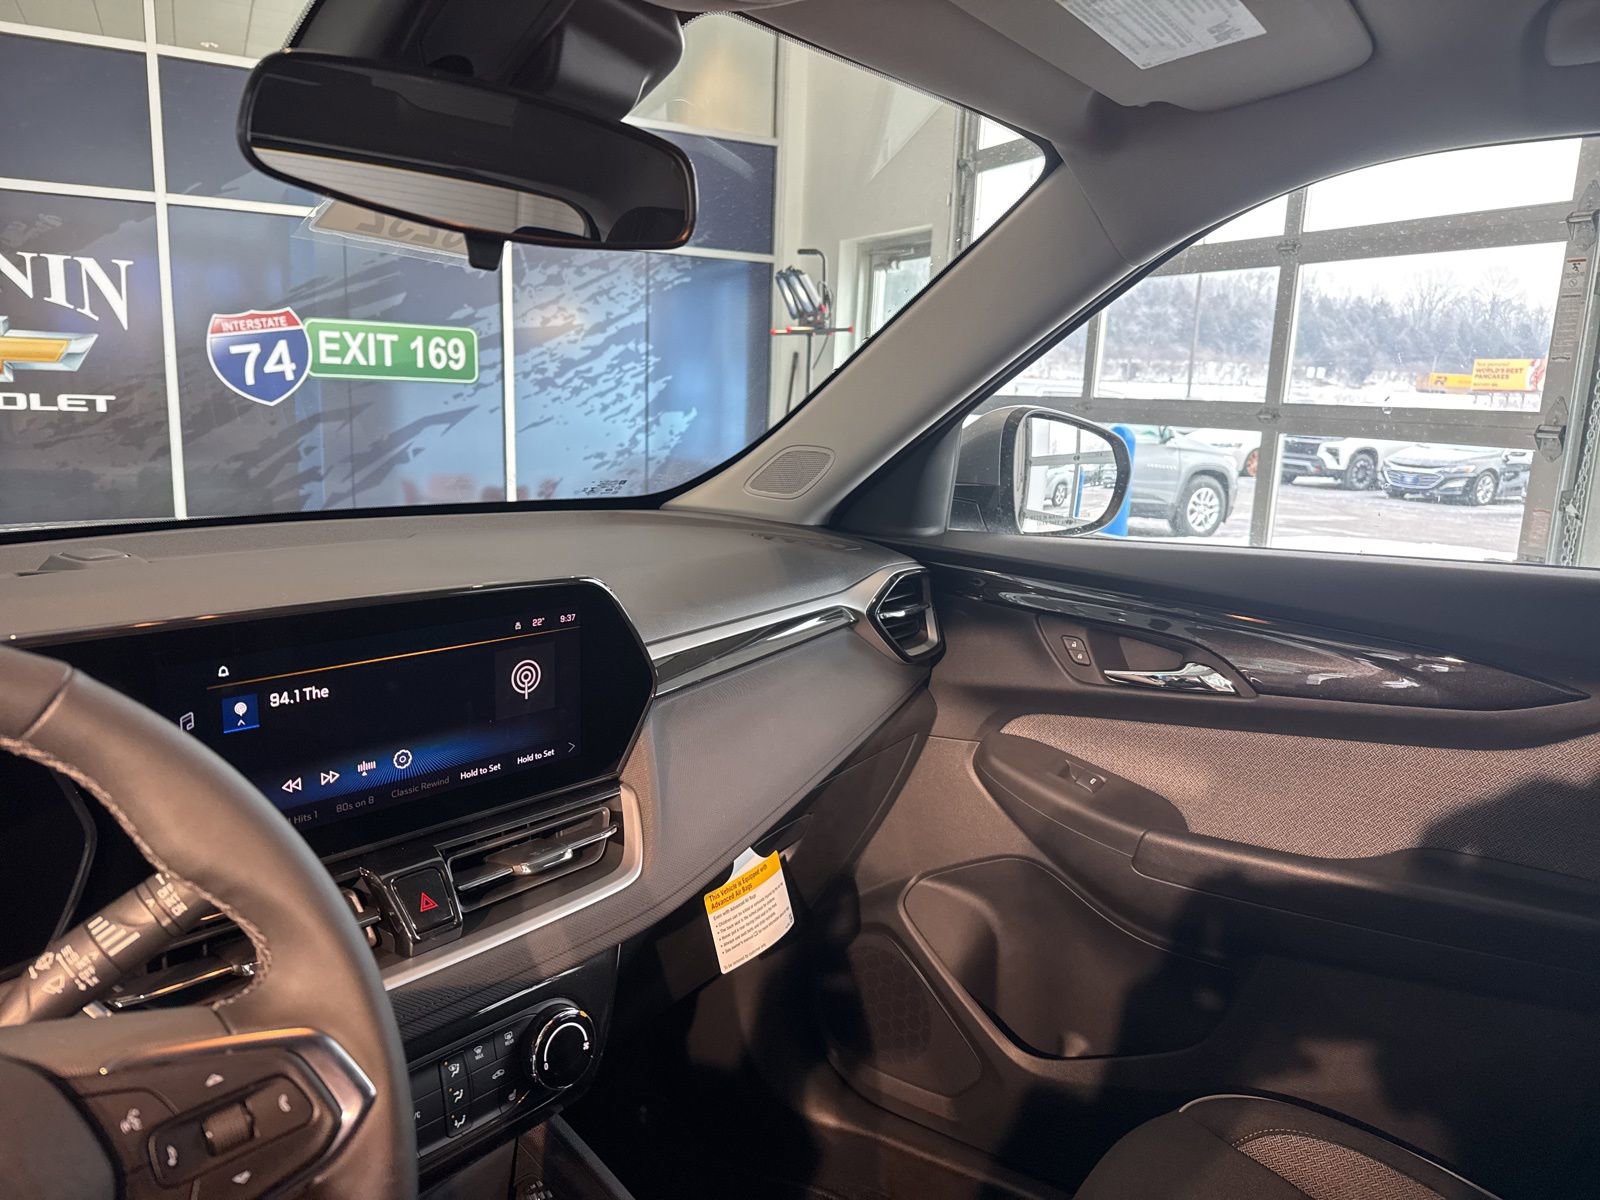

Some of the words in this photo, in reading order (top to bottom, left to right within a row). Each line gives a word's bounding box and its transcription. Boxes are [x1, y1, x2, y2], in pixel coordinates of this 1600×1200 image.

[220, 316, 288, 332] INTERSTATE
[318, 330, 399, 367] EXIT
[410, 335, 466, 371] 169
[229, 339, 296, 386] 74
[560, 613, 576, 623] 9:37
[269, 689, 300, 708] 94.1
[302, 685, 330, 701] The
[517, 753, 534, 765] Hold
[535, 752, 543, 760] to
[543, 748, 556, 757] Set
[460, 768, 479, 780] Hold
[479, 767, 488, 775] to
[488, 763, 502, 773] Set
[391, 786, 420, 799] Classic
[420, 776, 450, 791] Rewind
[354, 799, 367, 808] on
[368, 796, 375, 805] 8
